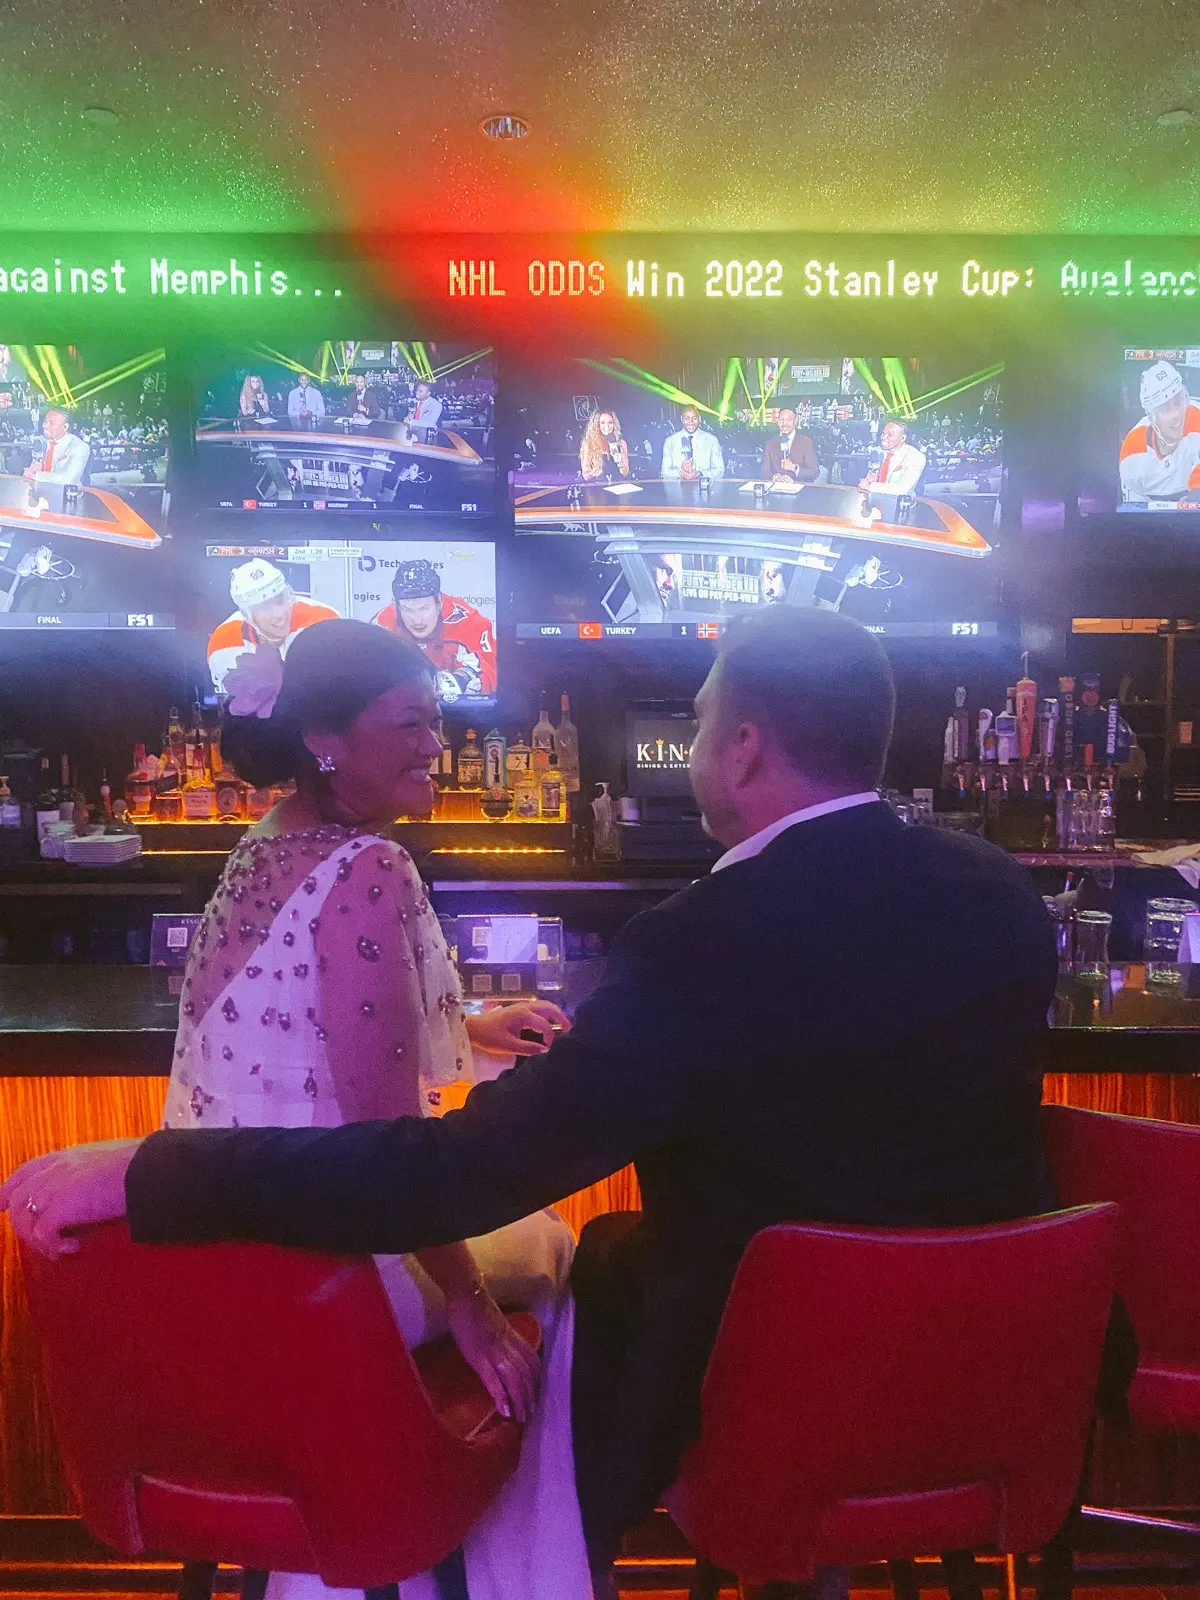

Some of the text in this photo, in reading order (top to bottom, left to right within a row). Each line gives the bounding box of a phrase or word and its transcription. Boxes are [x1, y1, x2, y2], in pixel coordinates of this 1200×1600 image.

[150, 258, 342, 296] Memphis...
[449, 260, 507, 296] NHL
[527, 260, 605, 296] ODDS
[626, 259, 685, 297] Win
[705, 259, 783, 297] 2022
[804, 259, 939, 297] Stanley
[962, 259, 1034, 297] Cup:
[461, 503, 477, 512] FS1
[239, 547, 245, 555] 3
[279, 547, 285, 555] 2
[37, 614, 154, 627] FINAL FS1
[540, 622, 979, 635] UEFA TURKEY 1 NAL FS1
[636, 743, 694, 762] KIN
